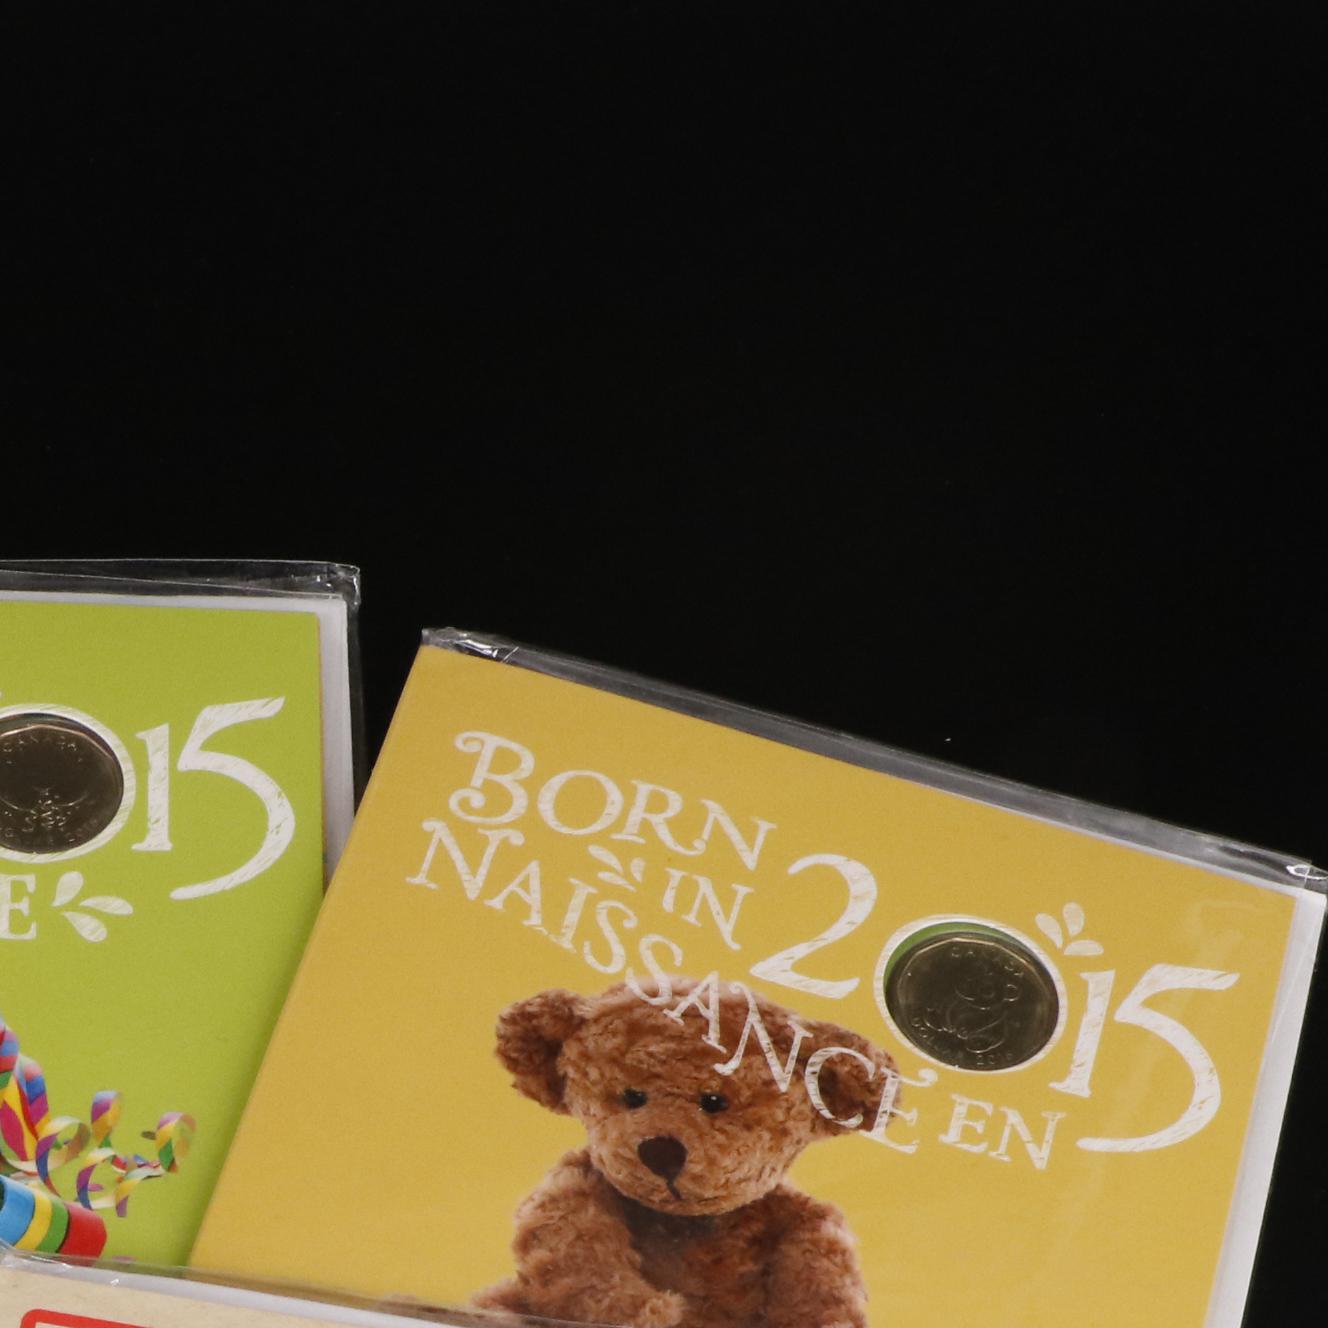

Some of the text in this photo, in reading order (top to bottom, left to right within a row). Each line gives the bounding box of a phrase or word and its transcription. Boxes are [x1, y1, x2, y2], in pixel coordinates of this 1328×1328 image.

[448, 731, 778, 871] BORN
[663, 868, 754, 950] IN
[406, 819, 1067, 1171] NAISSANCE EN
